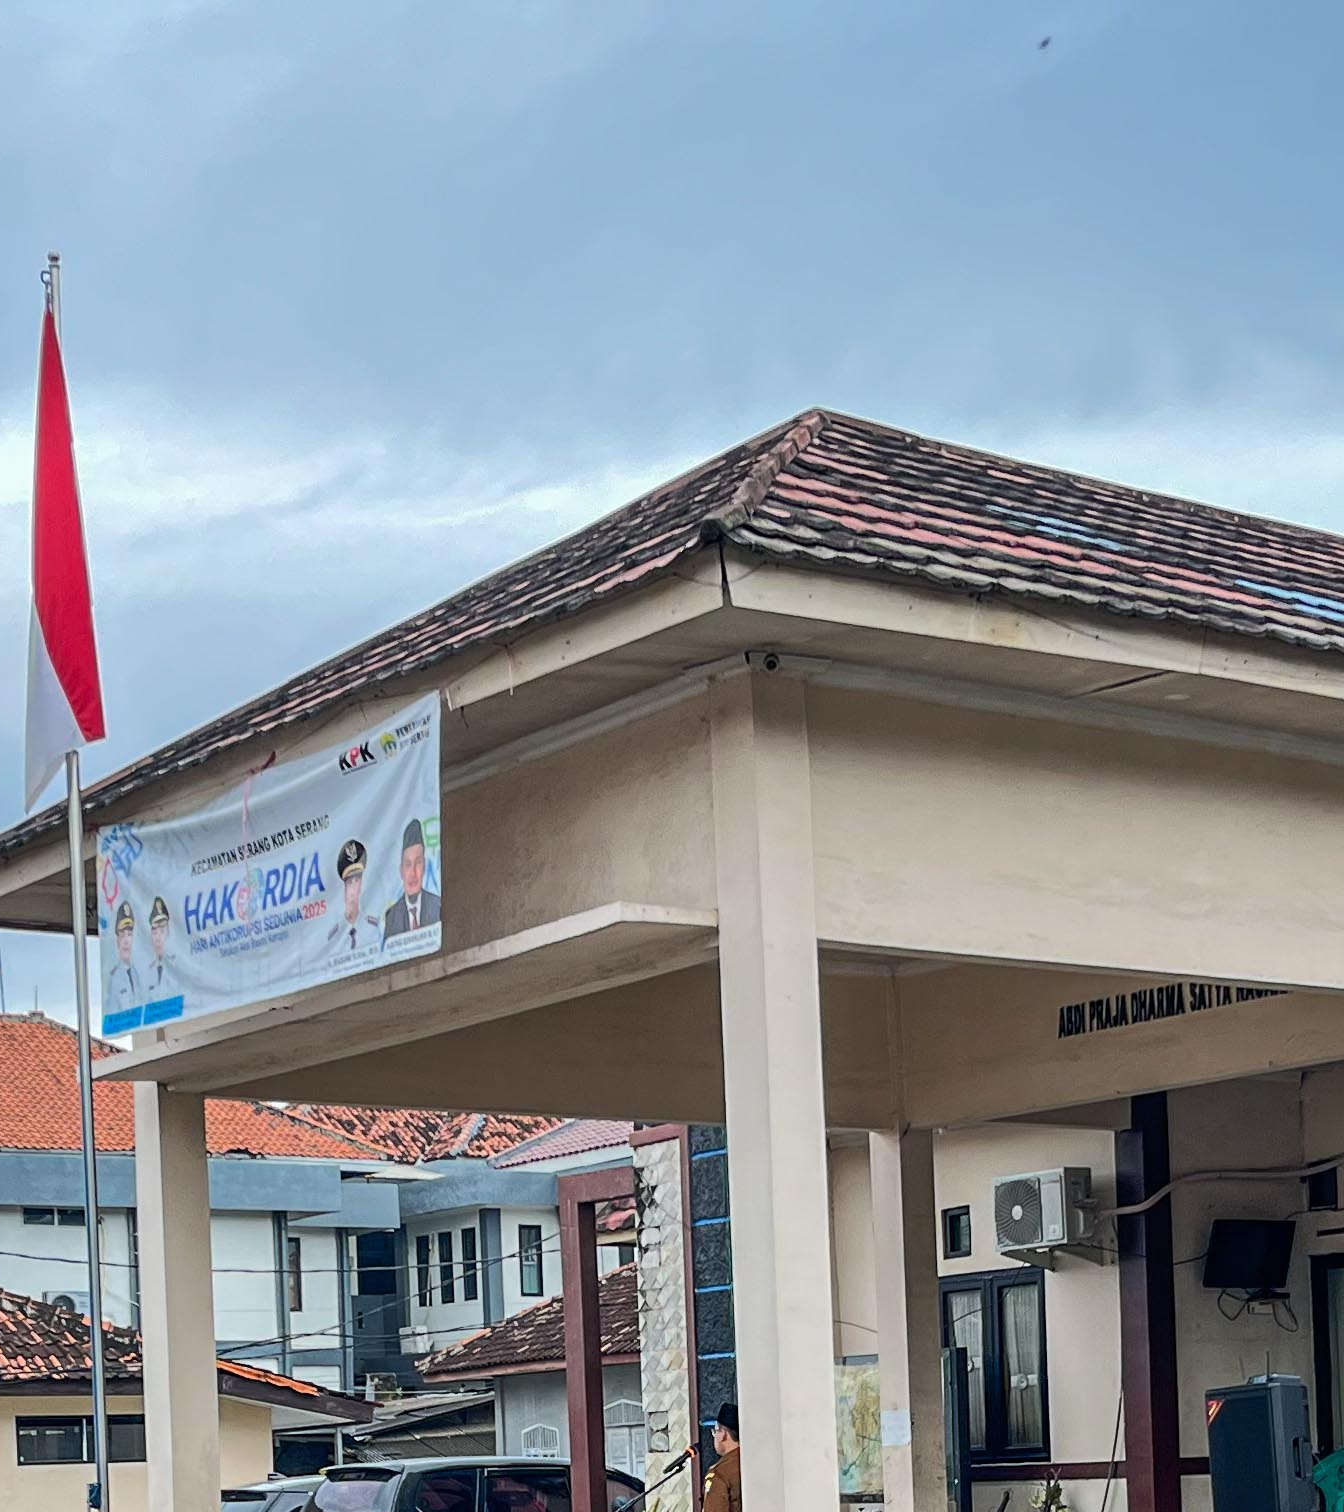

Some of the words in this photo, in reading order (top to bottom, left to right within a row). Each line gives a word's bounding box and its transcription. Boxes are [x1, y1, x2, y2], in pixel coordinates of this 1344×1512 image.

[339, 741, 376, 771] KPK
[191, 847, 241, 876] KECAMATAN
[271, 827, 295, 849] KOTA
[295, 814, 330, 840] SERANG
[303, 900, 328, 920] 2025
[1058, 1003, 1086, 1039] ABDI
[1089, 996, 1129, 1032] PRAJA
[1130, 982, 1186, 1024] DHARMA
